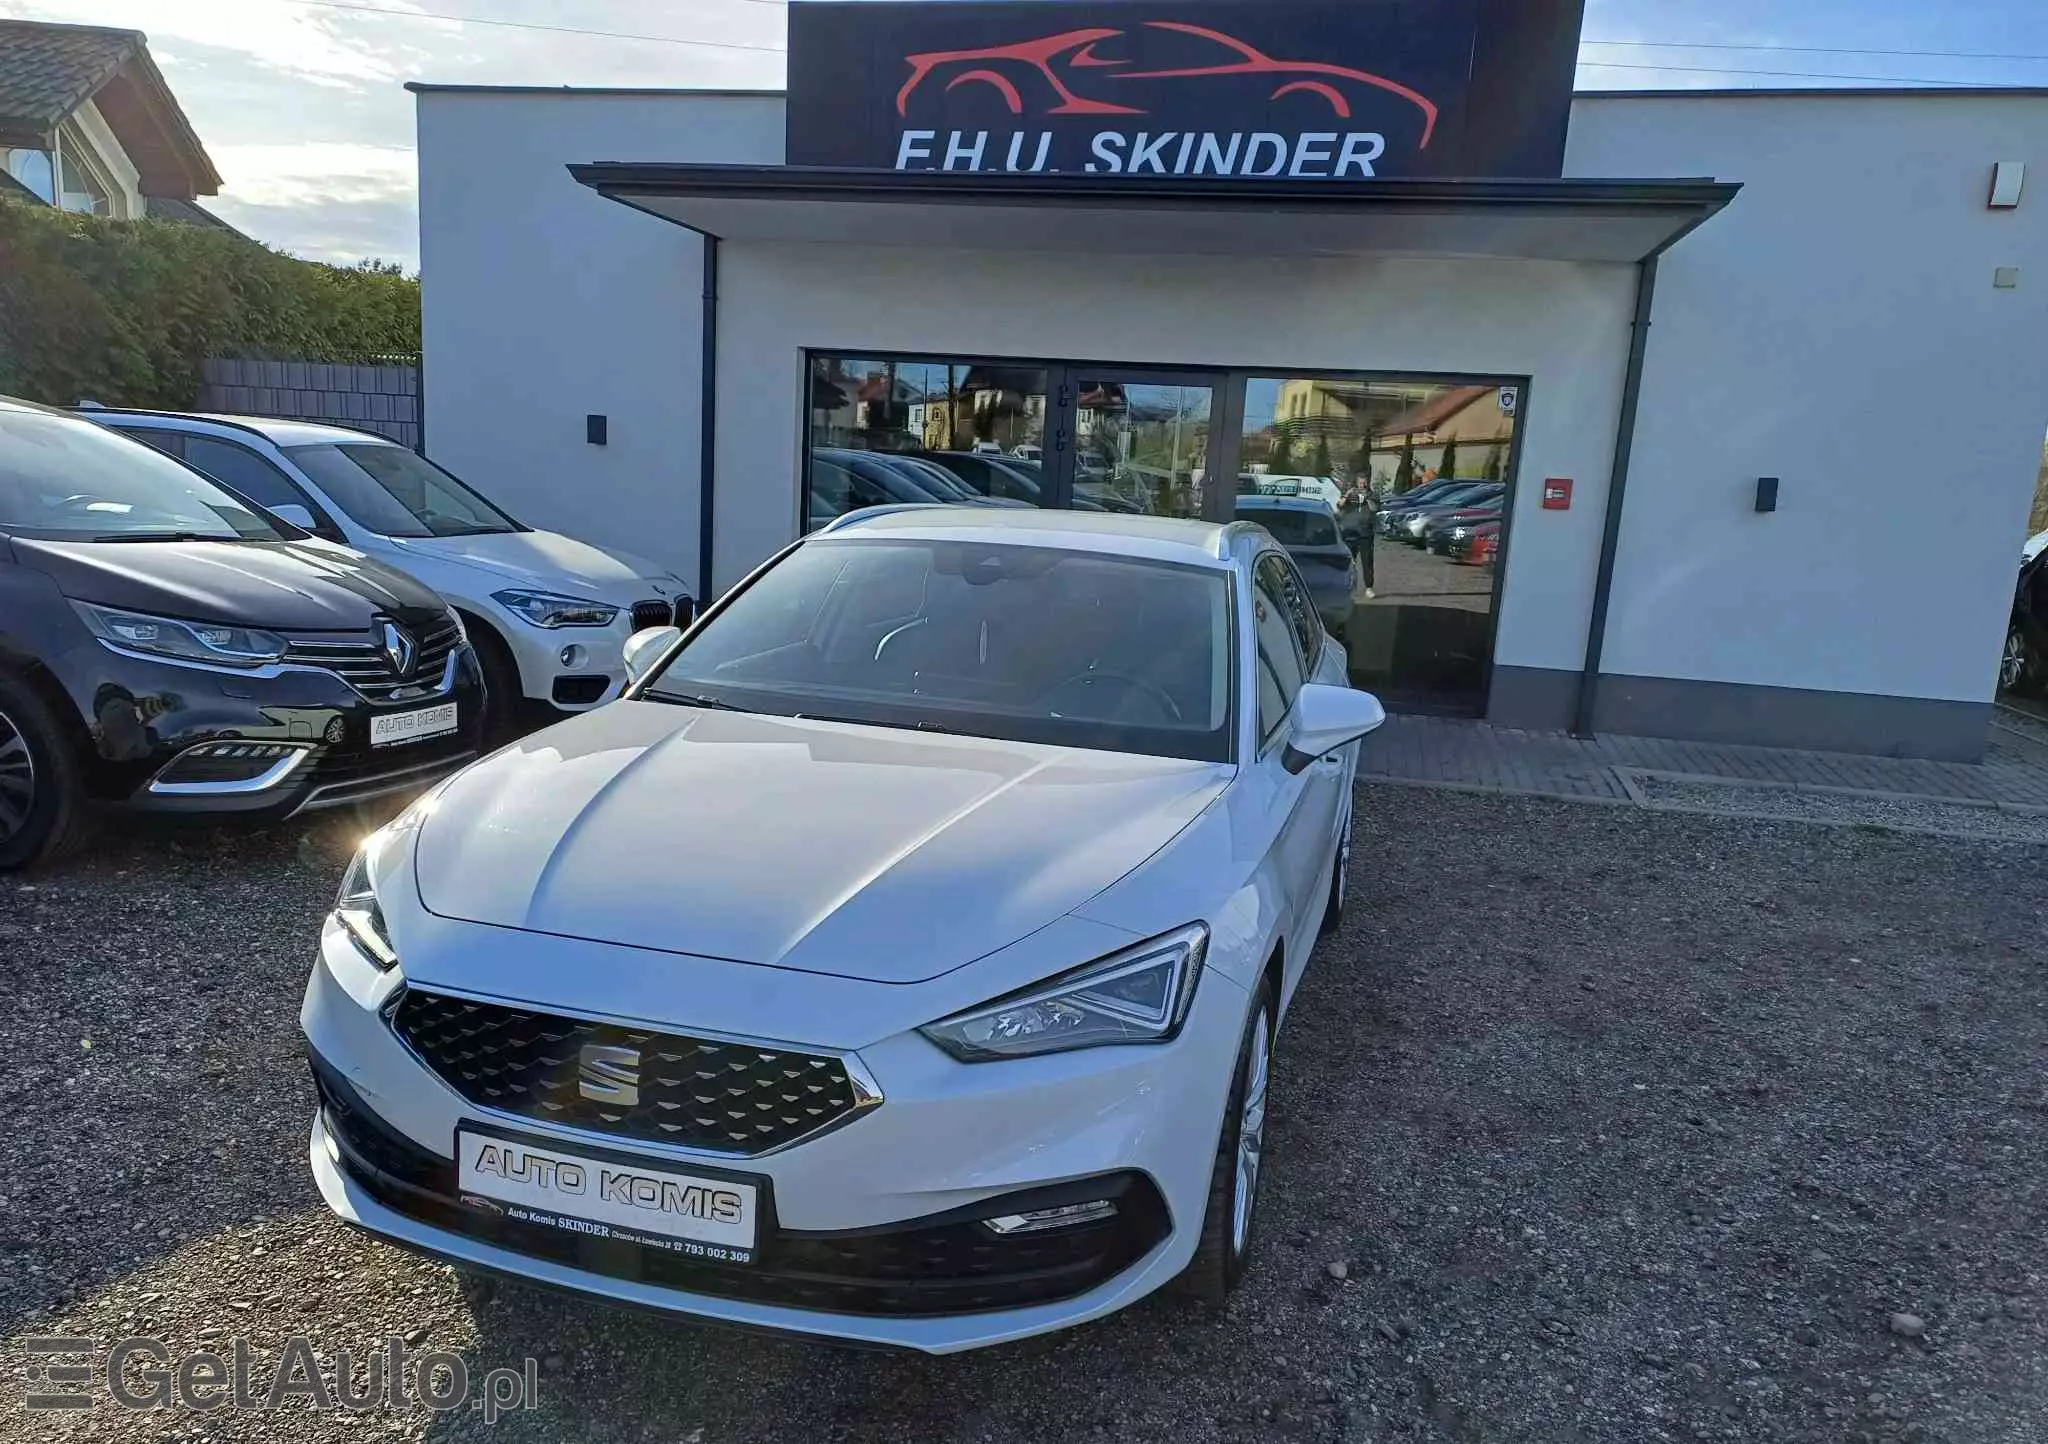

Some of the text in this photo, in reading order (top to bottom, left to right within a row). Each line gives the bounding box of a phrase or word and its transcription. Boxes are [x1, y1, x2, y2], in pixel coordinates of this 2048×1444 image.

[1084, 131, 1386, 177] SKINDER
[375, 715, 414, 734] AUTO
[475, 1144, 742, 1225] AUTO KOMIS
[508, 1207, 527, 1220] Auto
[529, 1212, 556, 1226] Komis
[558, 1217, 610, 1238] SKINDER
[684, 1243, 704, 1255] 793
[707, 1247, 727, 1259] 002
[729, 1251, 750, 1263] 309
